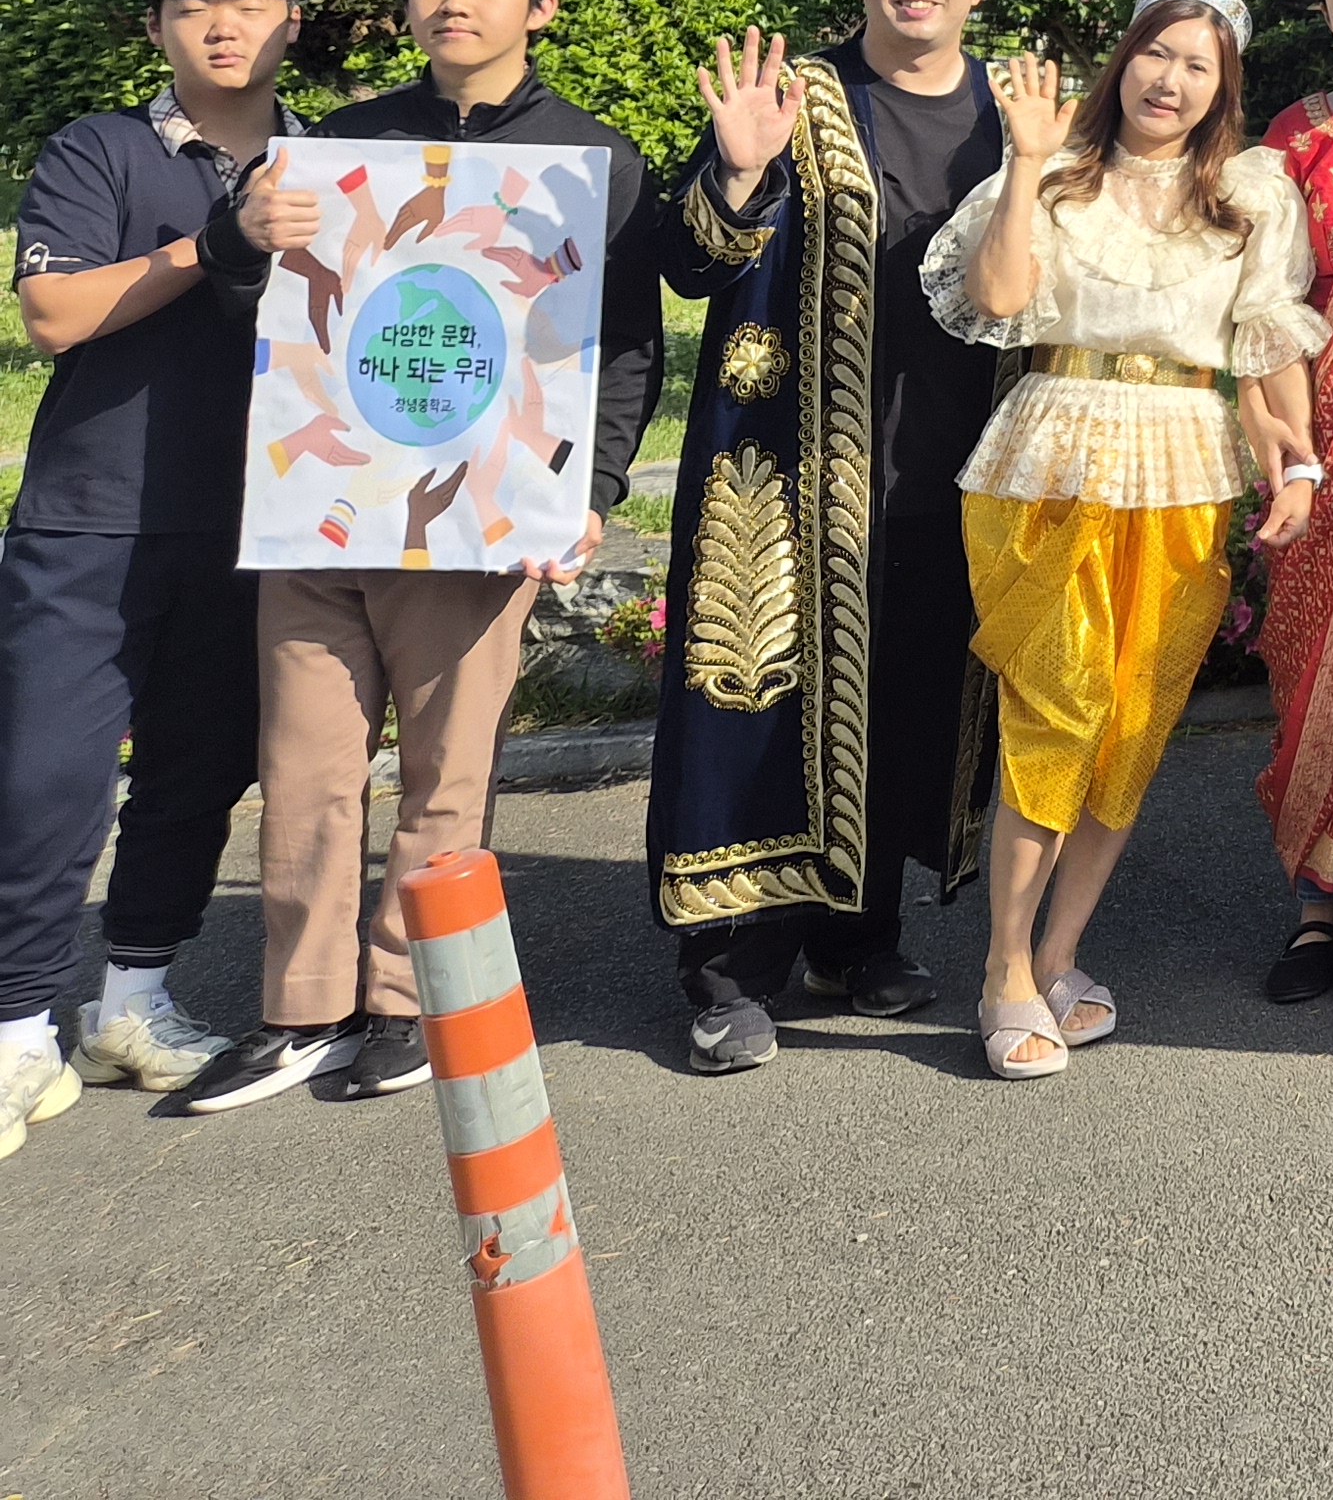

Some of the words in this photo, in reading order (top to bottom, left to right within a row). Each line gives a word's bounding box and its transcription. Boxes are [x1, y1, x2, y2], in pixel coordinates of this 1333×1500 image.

[381, 324, 435, 348] 다양한
[441, 324, 481, 350] 문화,
[358, 355, 400, 383] 하나
[406, 356, 447, 383] 되는
[453, 357, 494, 385] 우리
